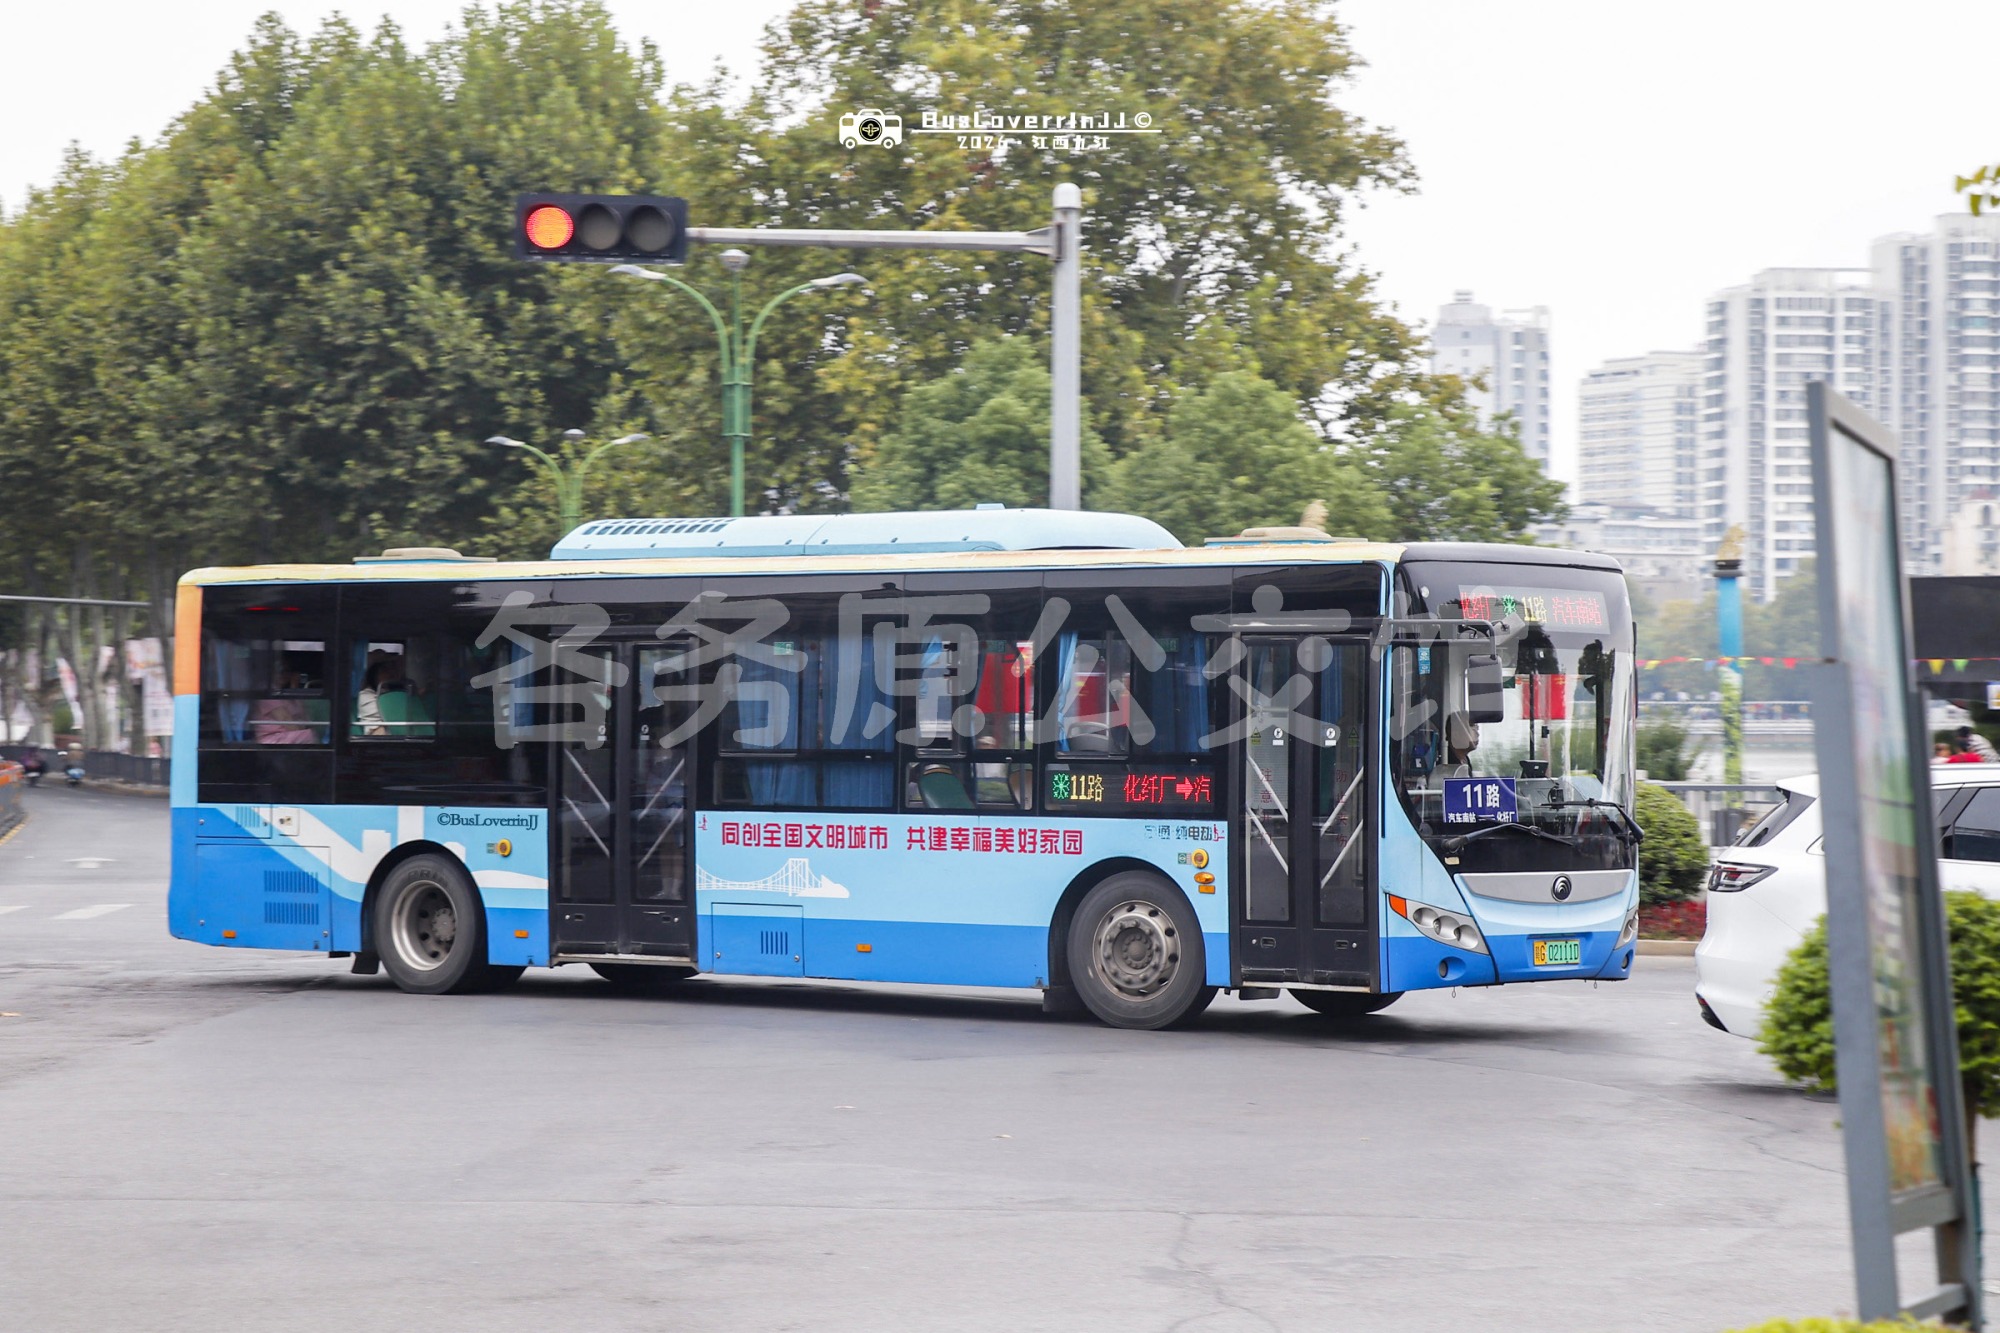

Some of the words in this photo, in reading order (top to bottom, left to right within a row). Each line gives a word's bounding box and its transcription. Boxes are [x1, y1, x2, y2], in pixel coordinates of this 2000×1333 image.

[1521, 595, 1548, 624] 11路
[1552, 596, 1602, 625] 汽车南站
[1070, 774, 1104, 802] 11路
[1462, 783, 1500, 808] 11路
[1447, 811, 1477, 823] 汽车南站
[1496, 810, 1516, 823] 化纤厂
[722, 821, 889, 850] 同创全国文明城市
[907, 825, 1083, 855] 共建幸福美好家园
